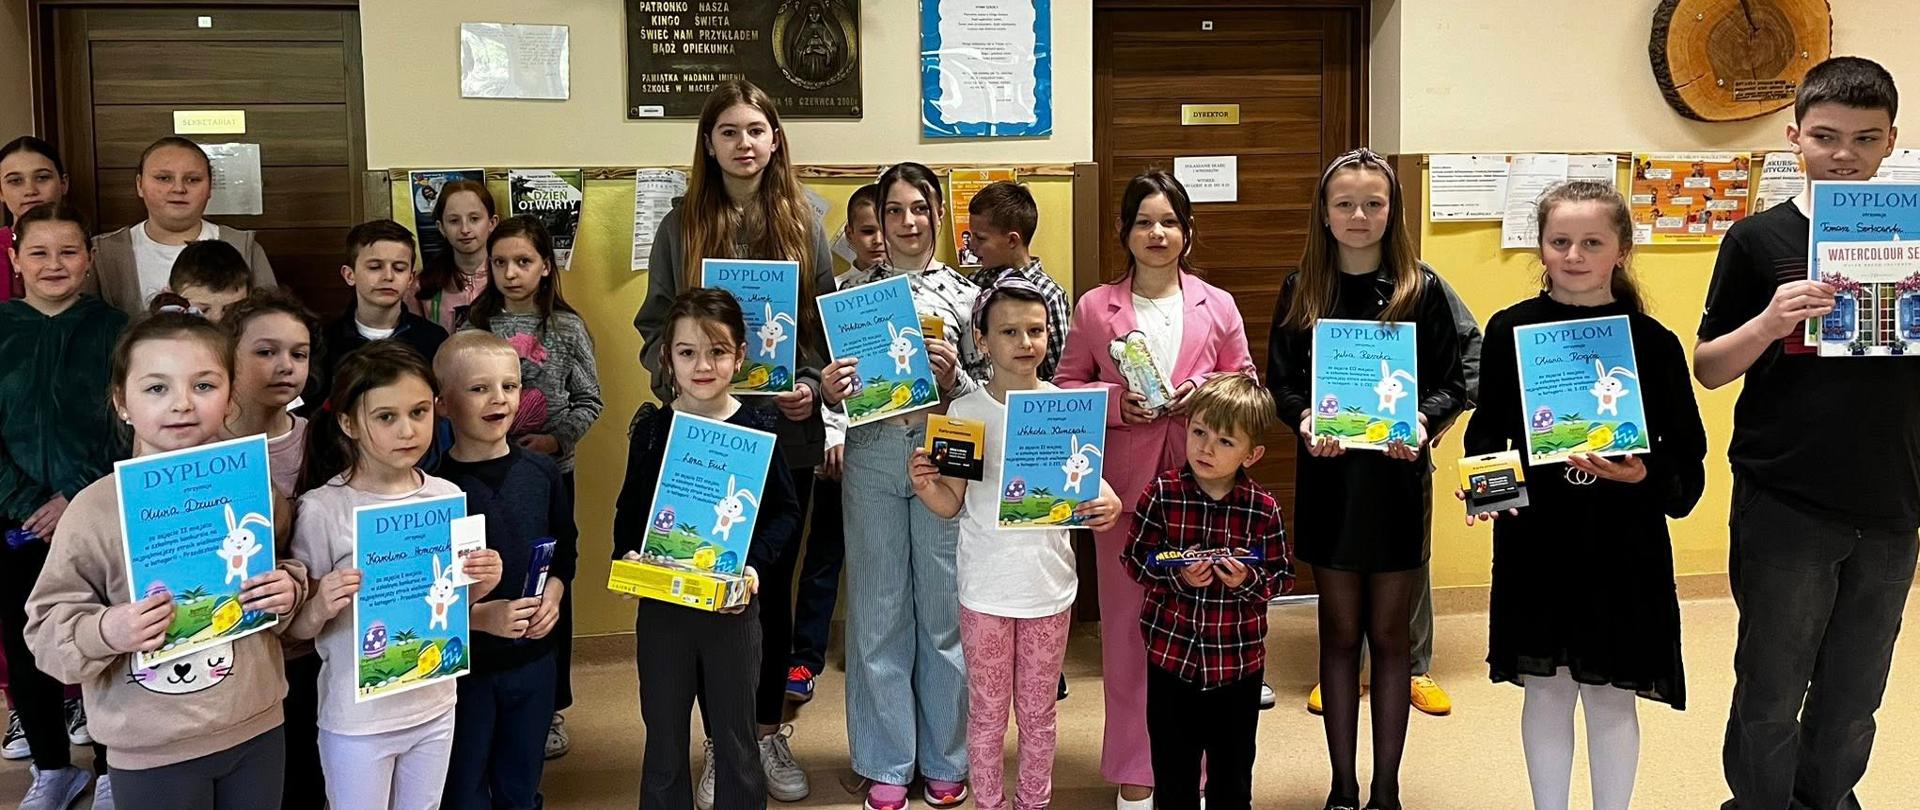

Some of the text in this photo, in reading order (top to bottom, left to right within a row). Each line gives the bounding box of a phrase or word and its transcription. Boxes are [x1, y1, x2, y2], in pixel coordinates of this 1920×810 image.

[640, 2, 730, 12] PATRONKO NASZA
[652, 13, 730, 27] KINGO ŚWIĘTA
[640, 26, 758, 40] ŚWIEĆ NAM PRZYKŁADEM
[642, 74, 678, 83] PAMIĄTKA
[534, 189, 567, 200] DZIEŃ
[1833, 192, 1918, 207] DYPLOM
[518, 200, 576, 210] OTWARTY
[1828, 248, 1903, 260] WATERCOLOUR
[719, 269, 784, 282] DYPLOM
[834, 286, 898, 313] DYPLOM
[1331, 328, 1400, 341] DYPLOM
[1535, 325, 1613, 344] DYPLOM
[1024, 398, 1092, 414] DYPLOM
[688, 426, 758, 454] DYPLOM
[144, 452, 248, 489] DYPLOM
[140, 507, 180, 522] Oliwia
[376, 508, 451, 534] DYPLOM
[366, 552, 407, 565] Karolina
[1156, 552, 1180, 560] MEGA
